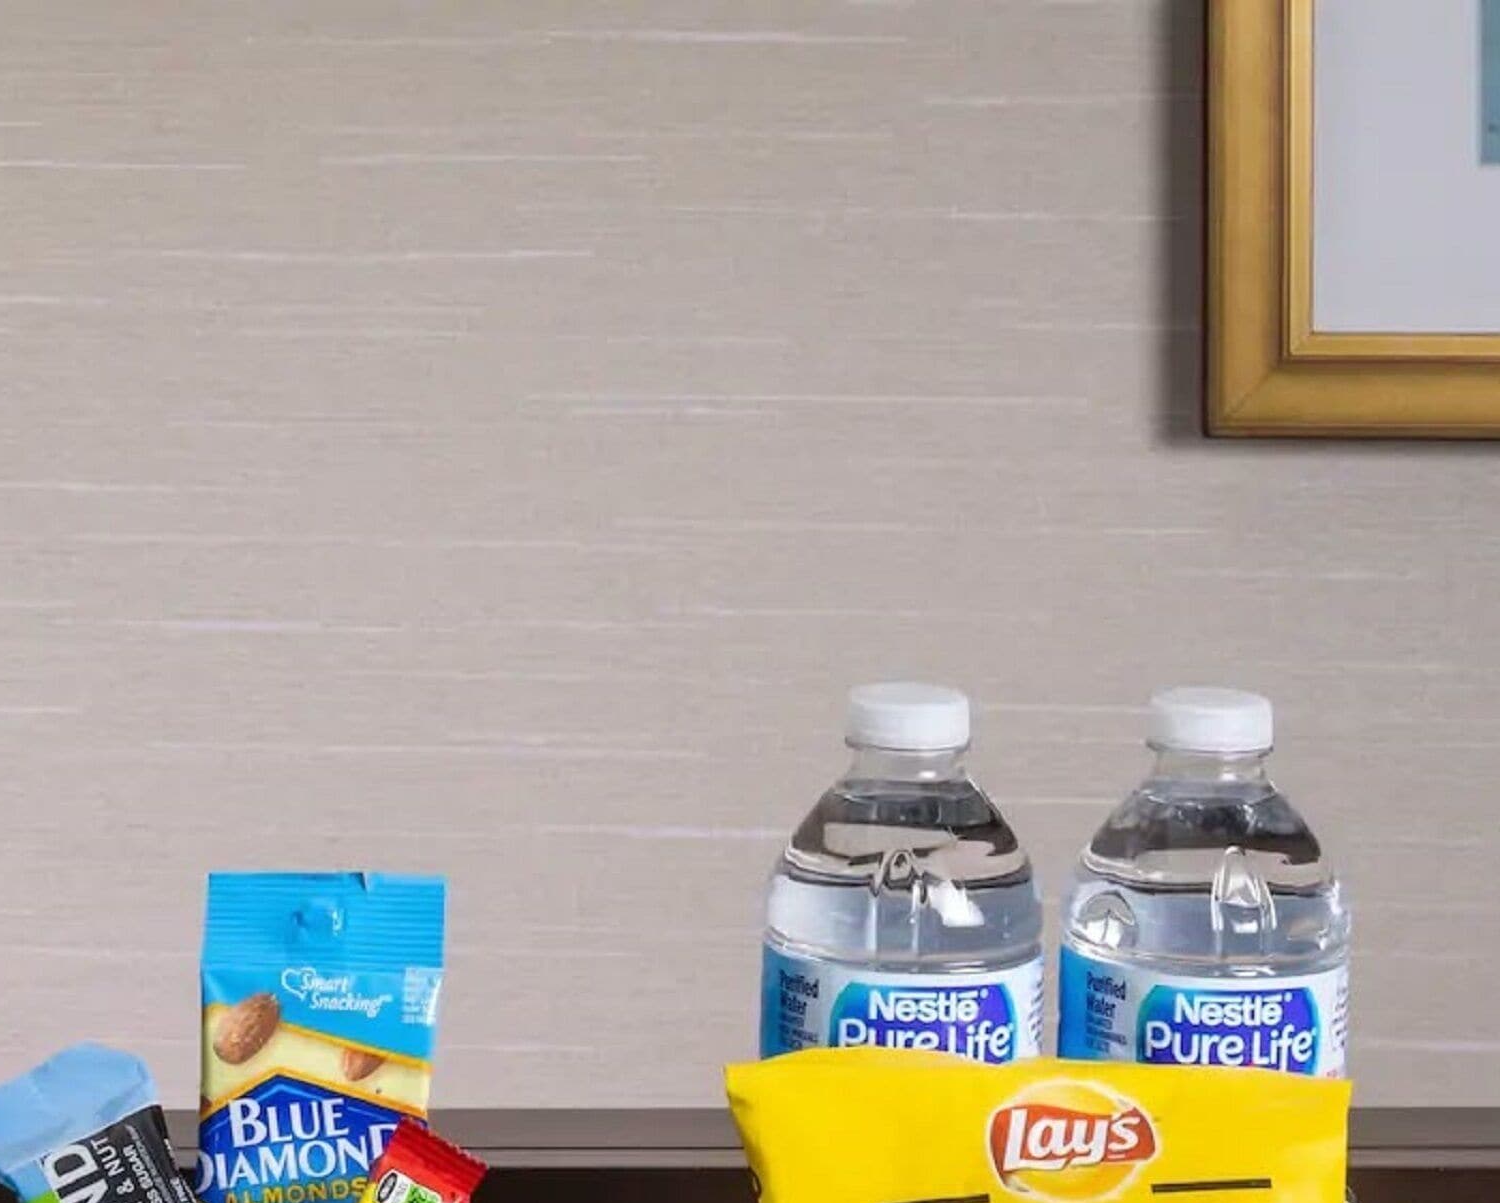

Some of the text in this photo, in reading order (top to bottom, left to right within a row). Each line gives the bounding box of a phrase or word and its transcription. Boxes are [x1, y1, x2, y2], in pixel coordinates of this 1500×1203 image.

[301, 972, 348, 993] Smart
[868, 988, 981, 1023] Nestlé
[1173, 992, 1283, 1027] Nestlé
[837, 1018, 940, 1051] Pure
[948, 1021, 1012, 1063] Life
[1145, 1020, 1245, 1066] Pure
[1252, 1024, 1314, 1073] Life
[228, 1097, 349, 1148] BLUE
[1003, 1107, 1141, 1171] Lay's
[90, 1136, 125, 1178] NUT
[122, 1144, 154, 1191] SUGAR
[116, 1178, 135, 1195] &
